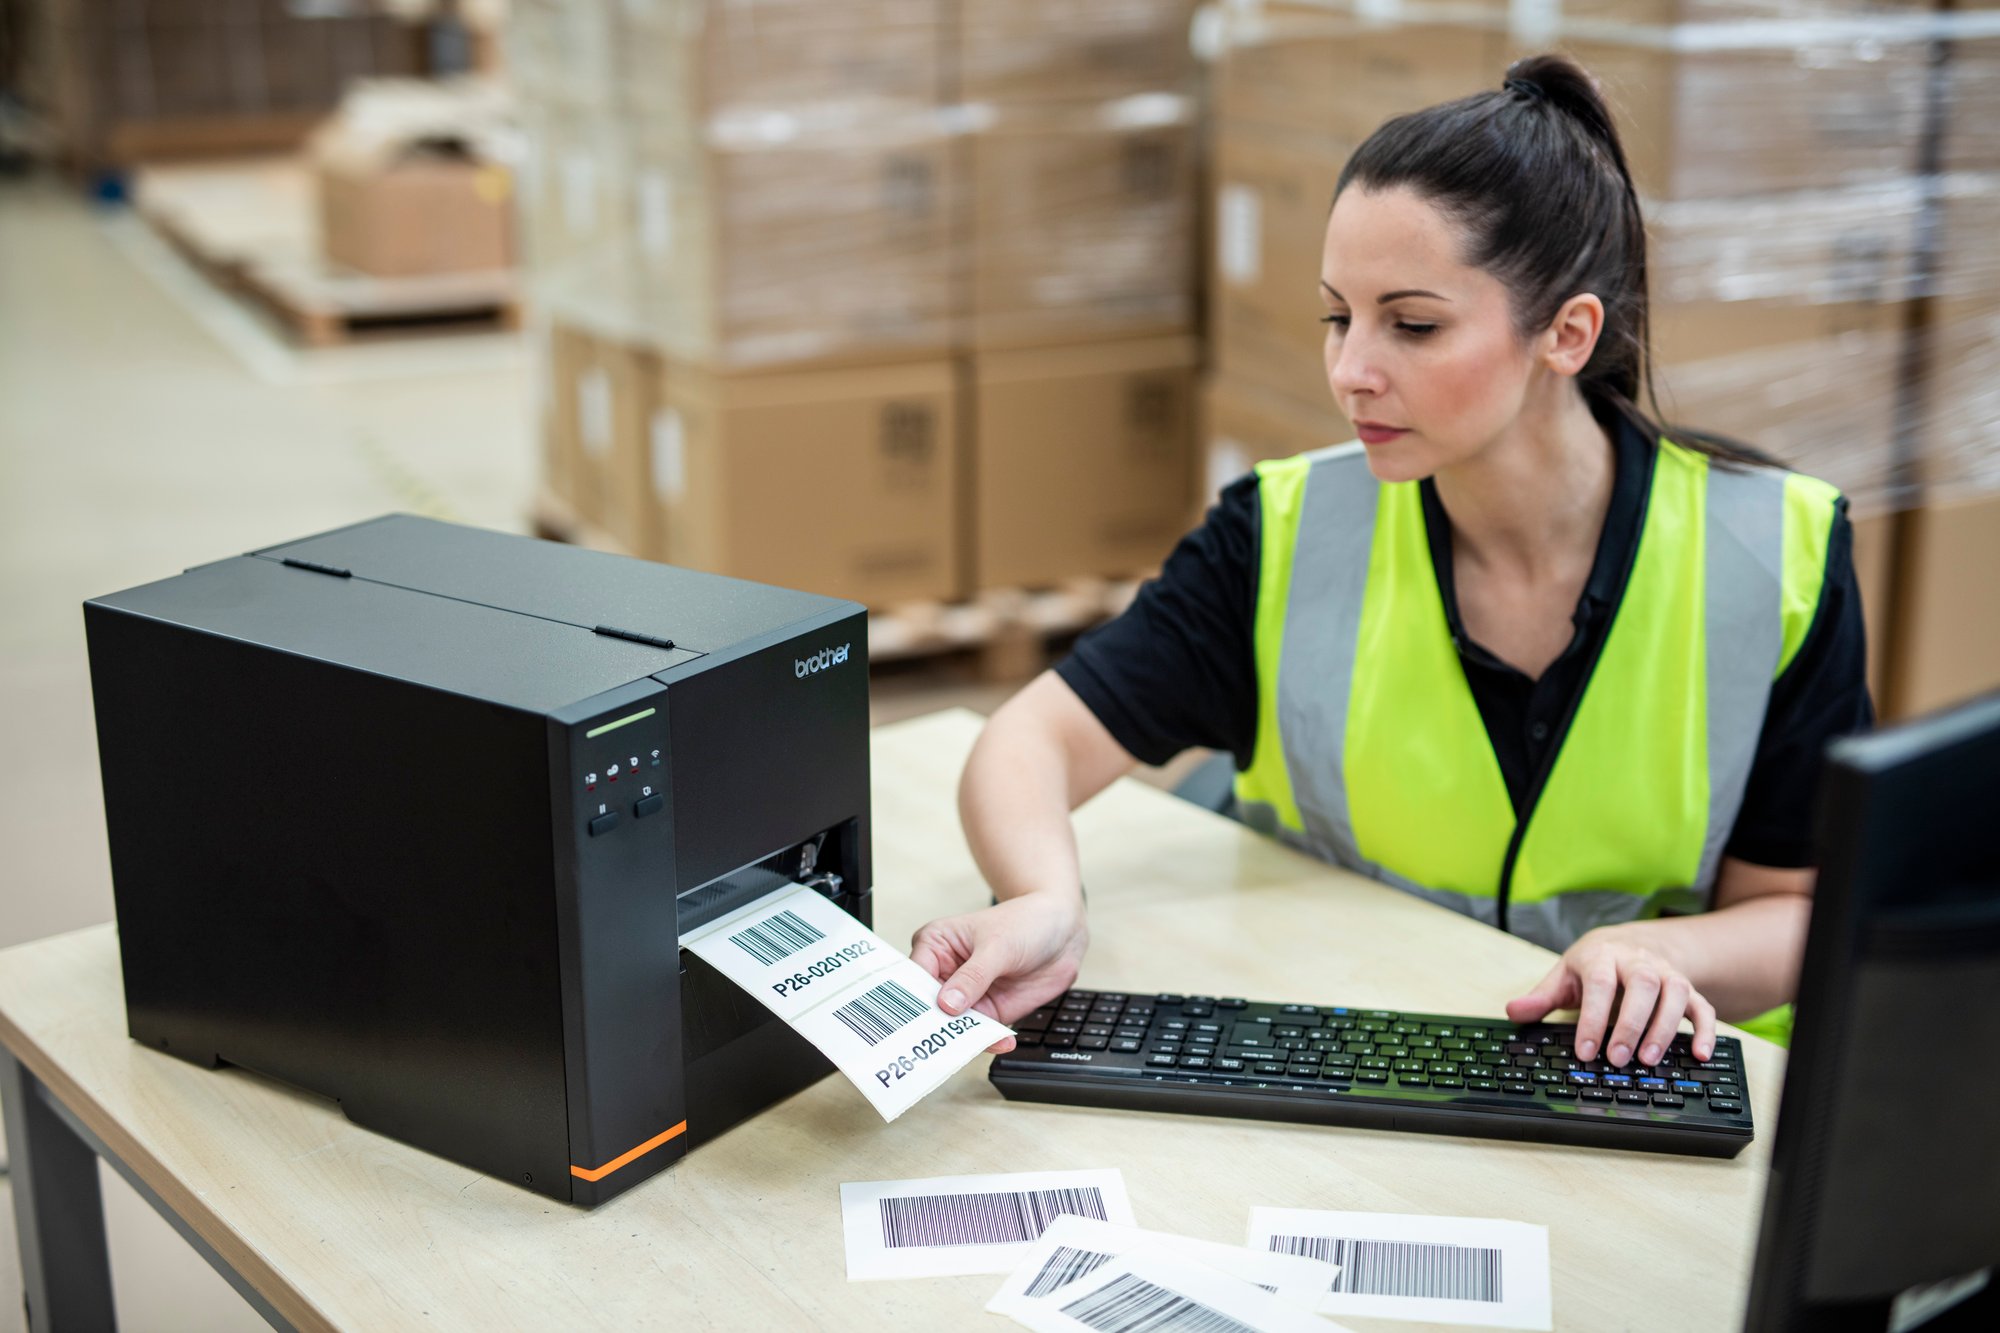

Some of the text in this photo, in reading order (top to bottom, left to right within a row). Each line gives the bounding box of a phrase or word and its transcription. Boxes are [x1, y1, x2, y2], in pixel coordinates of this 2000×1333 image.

[794, 643, 850, 678] brother
[772, 940, 877, 997] P26-0201922
[875, 1016, 981, 1088] P26-0201922
[1050, 1052, 1092, 1061] rapoo
